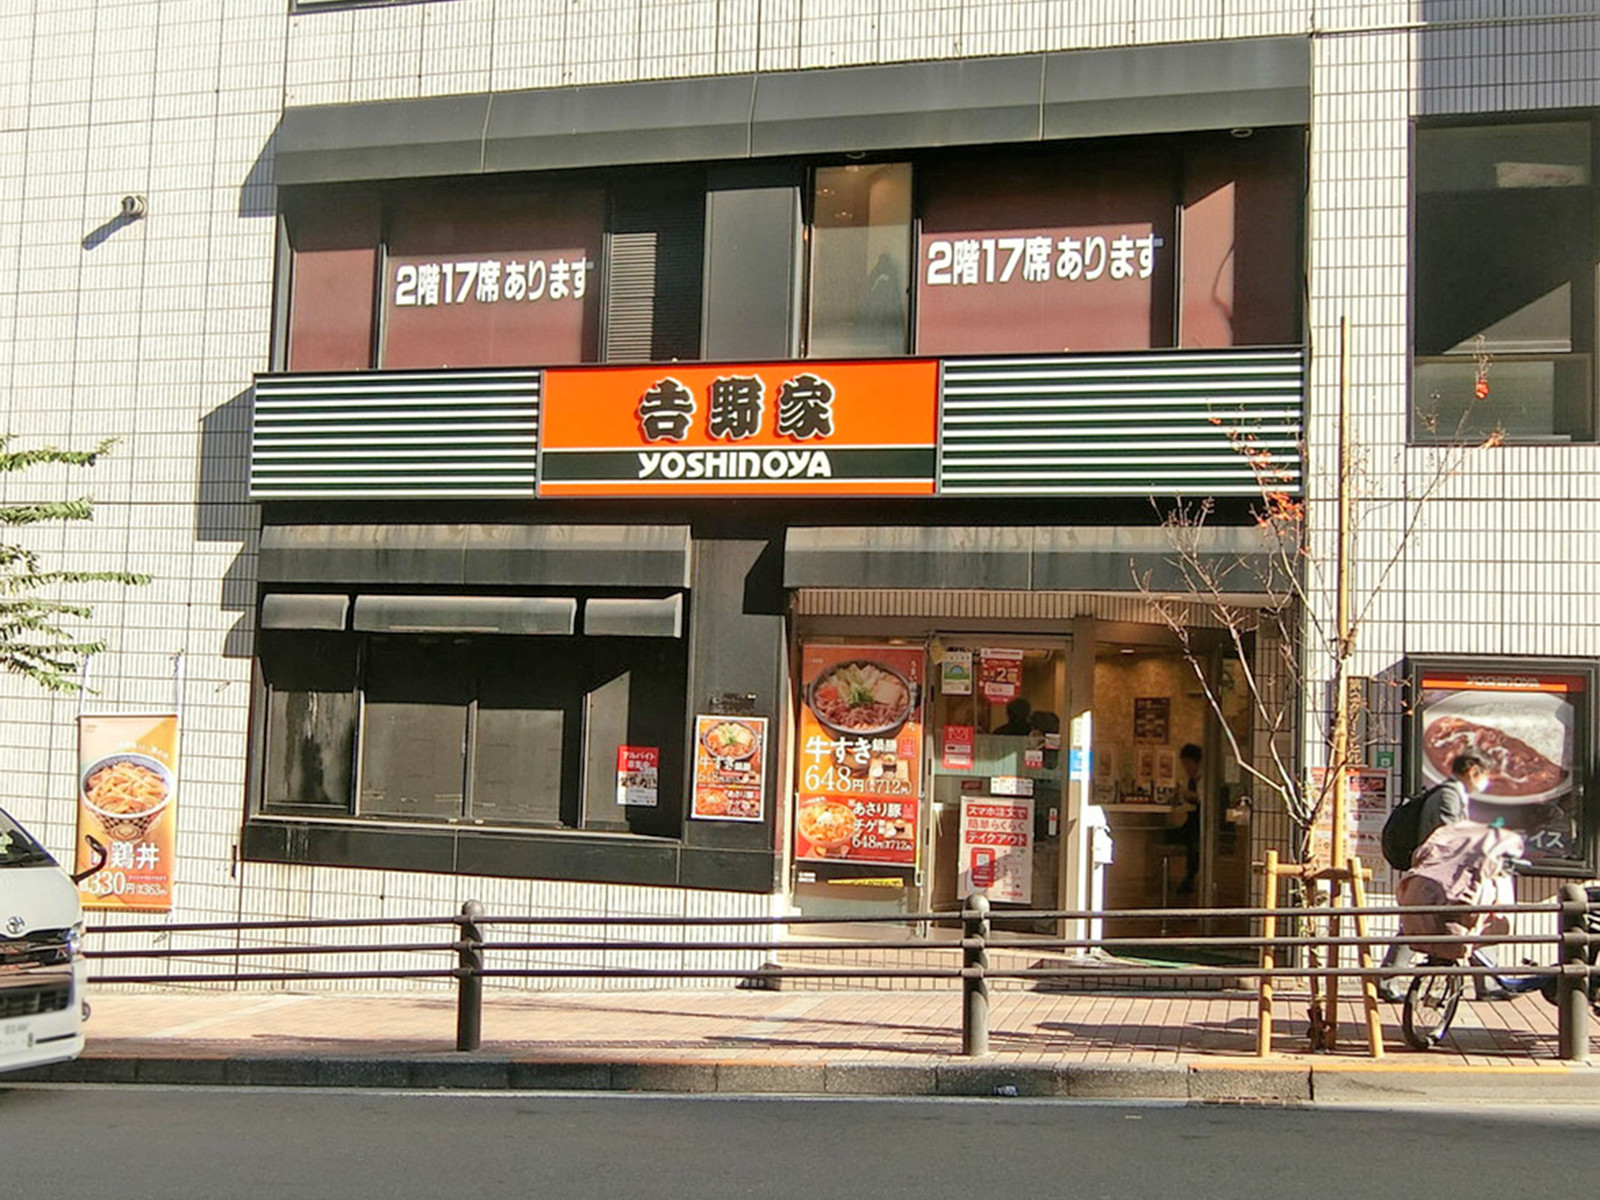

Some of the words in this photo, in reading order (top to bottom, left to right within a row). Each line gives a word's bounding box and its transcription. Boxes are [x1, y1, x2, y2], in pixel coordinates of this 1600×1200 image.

[638, 373, 835, 443] 吉野家
[637, 450, 832, 479] YOSHINOYA
[967, 831, 1025, 845] テイクアウト
